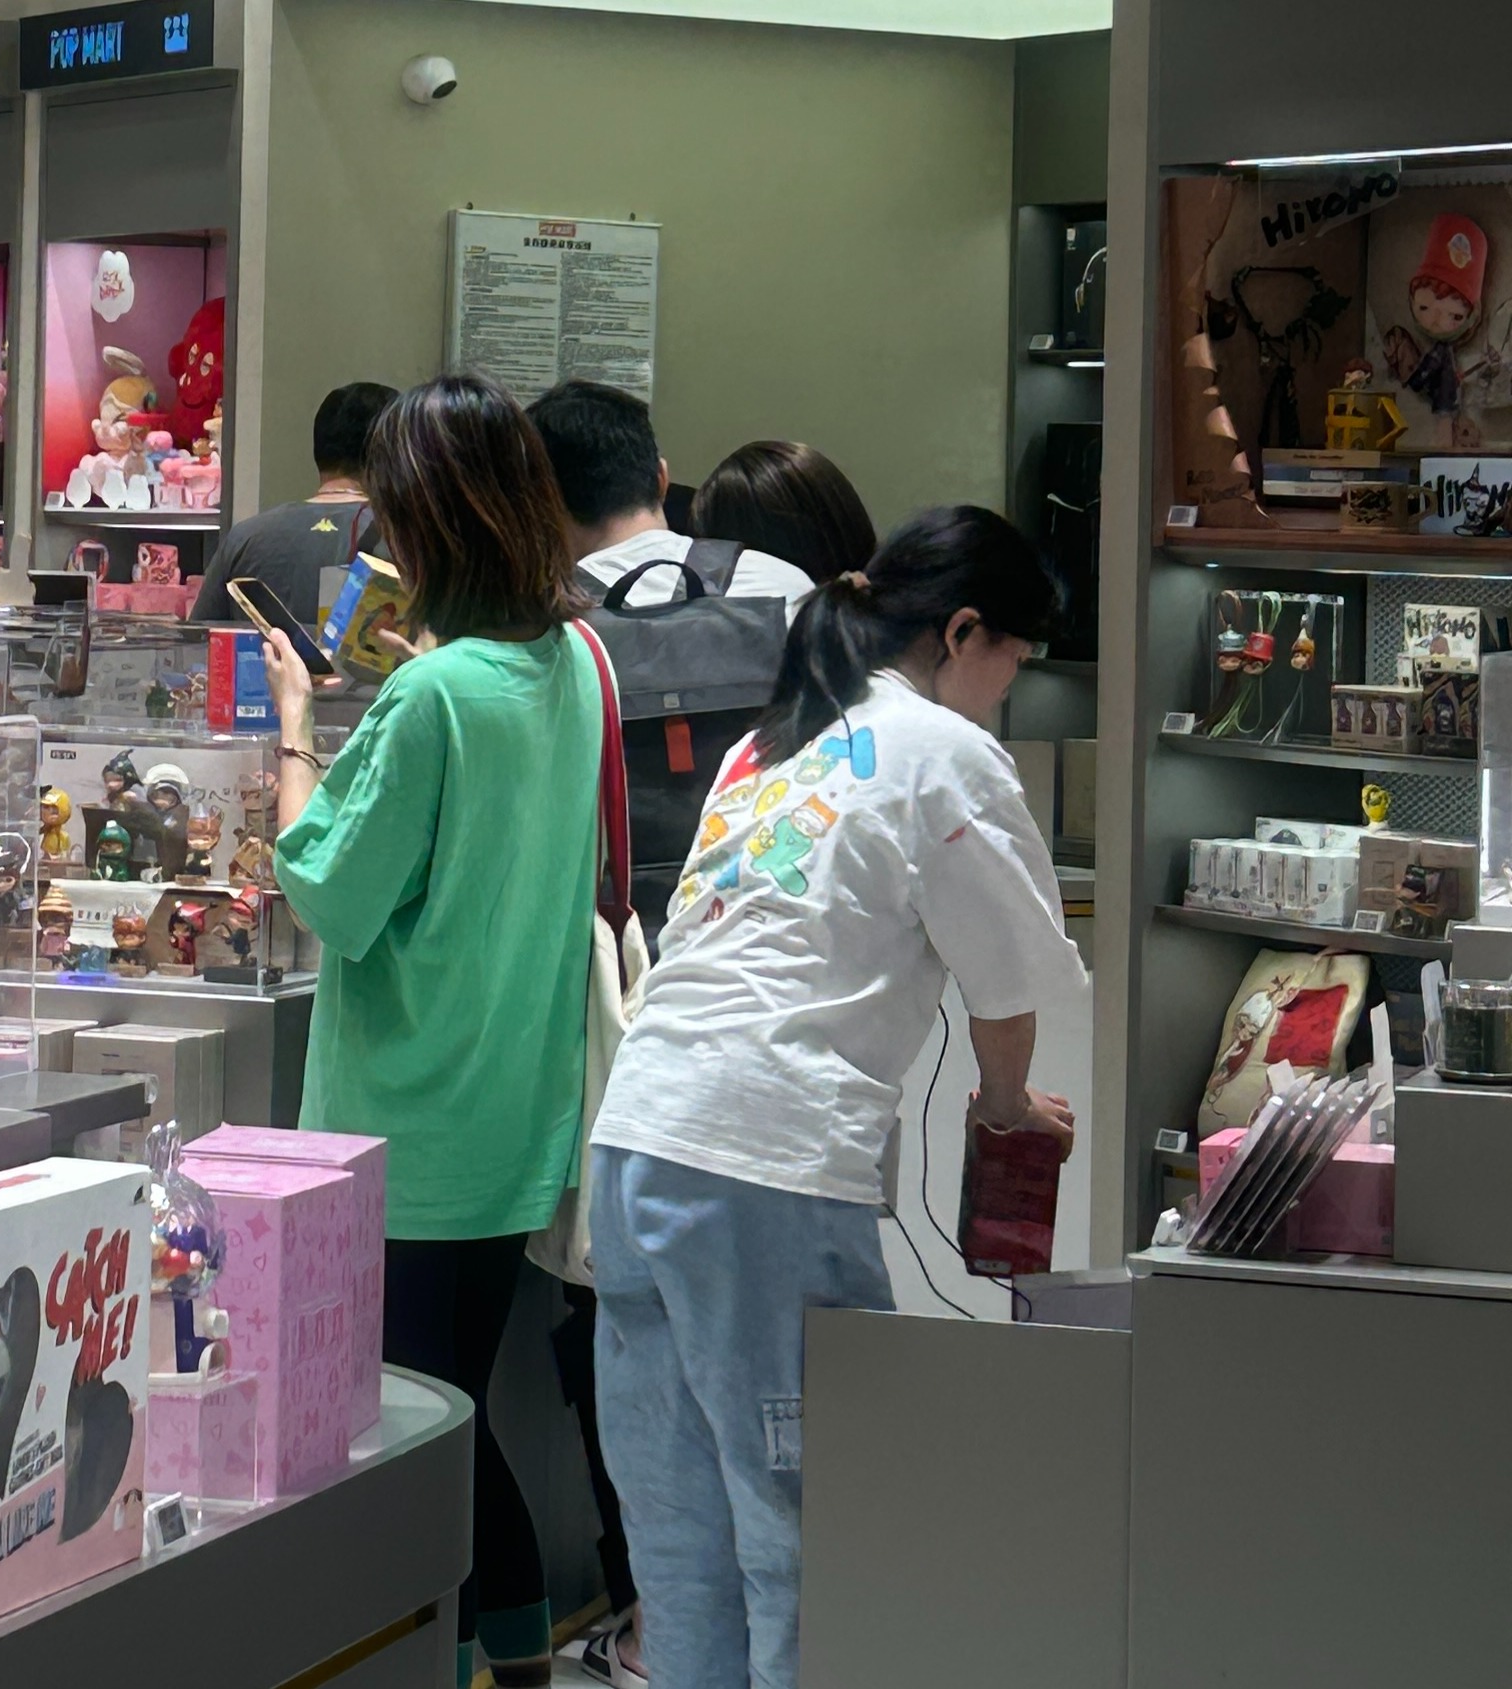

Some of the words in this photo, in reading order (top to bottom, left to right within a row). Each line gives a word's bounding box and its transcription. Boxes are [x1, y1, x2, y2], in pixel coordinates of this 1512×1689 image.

[50, 27, 79, 69] POP
[82, 21, 125, 67] MART
[45, 1226, 131, 1347] CATCH
[76, 1293, 140, 1386] ME!
